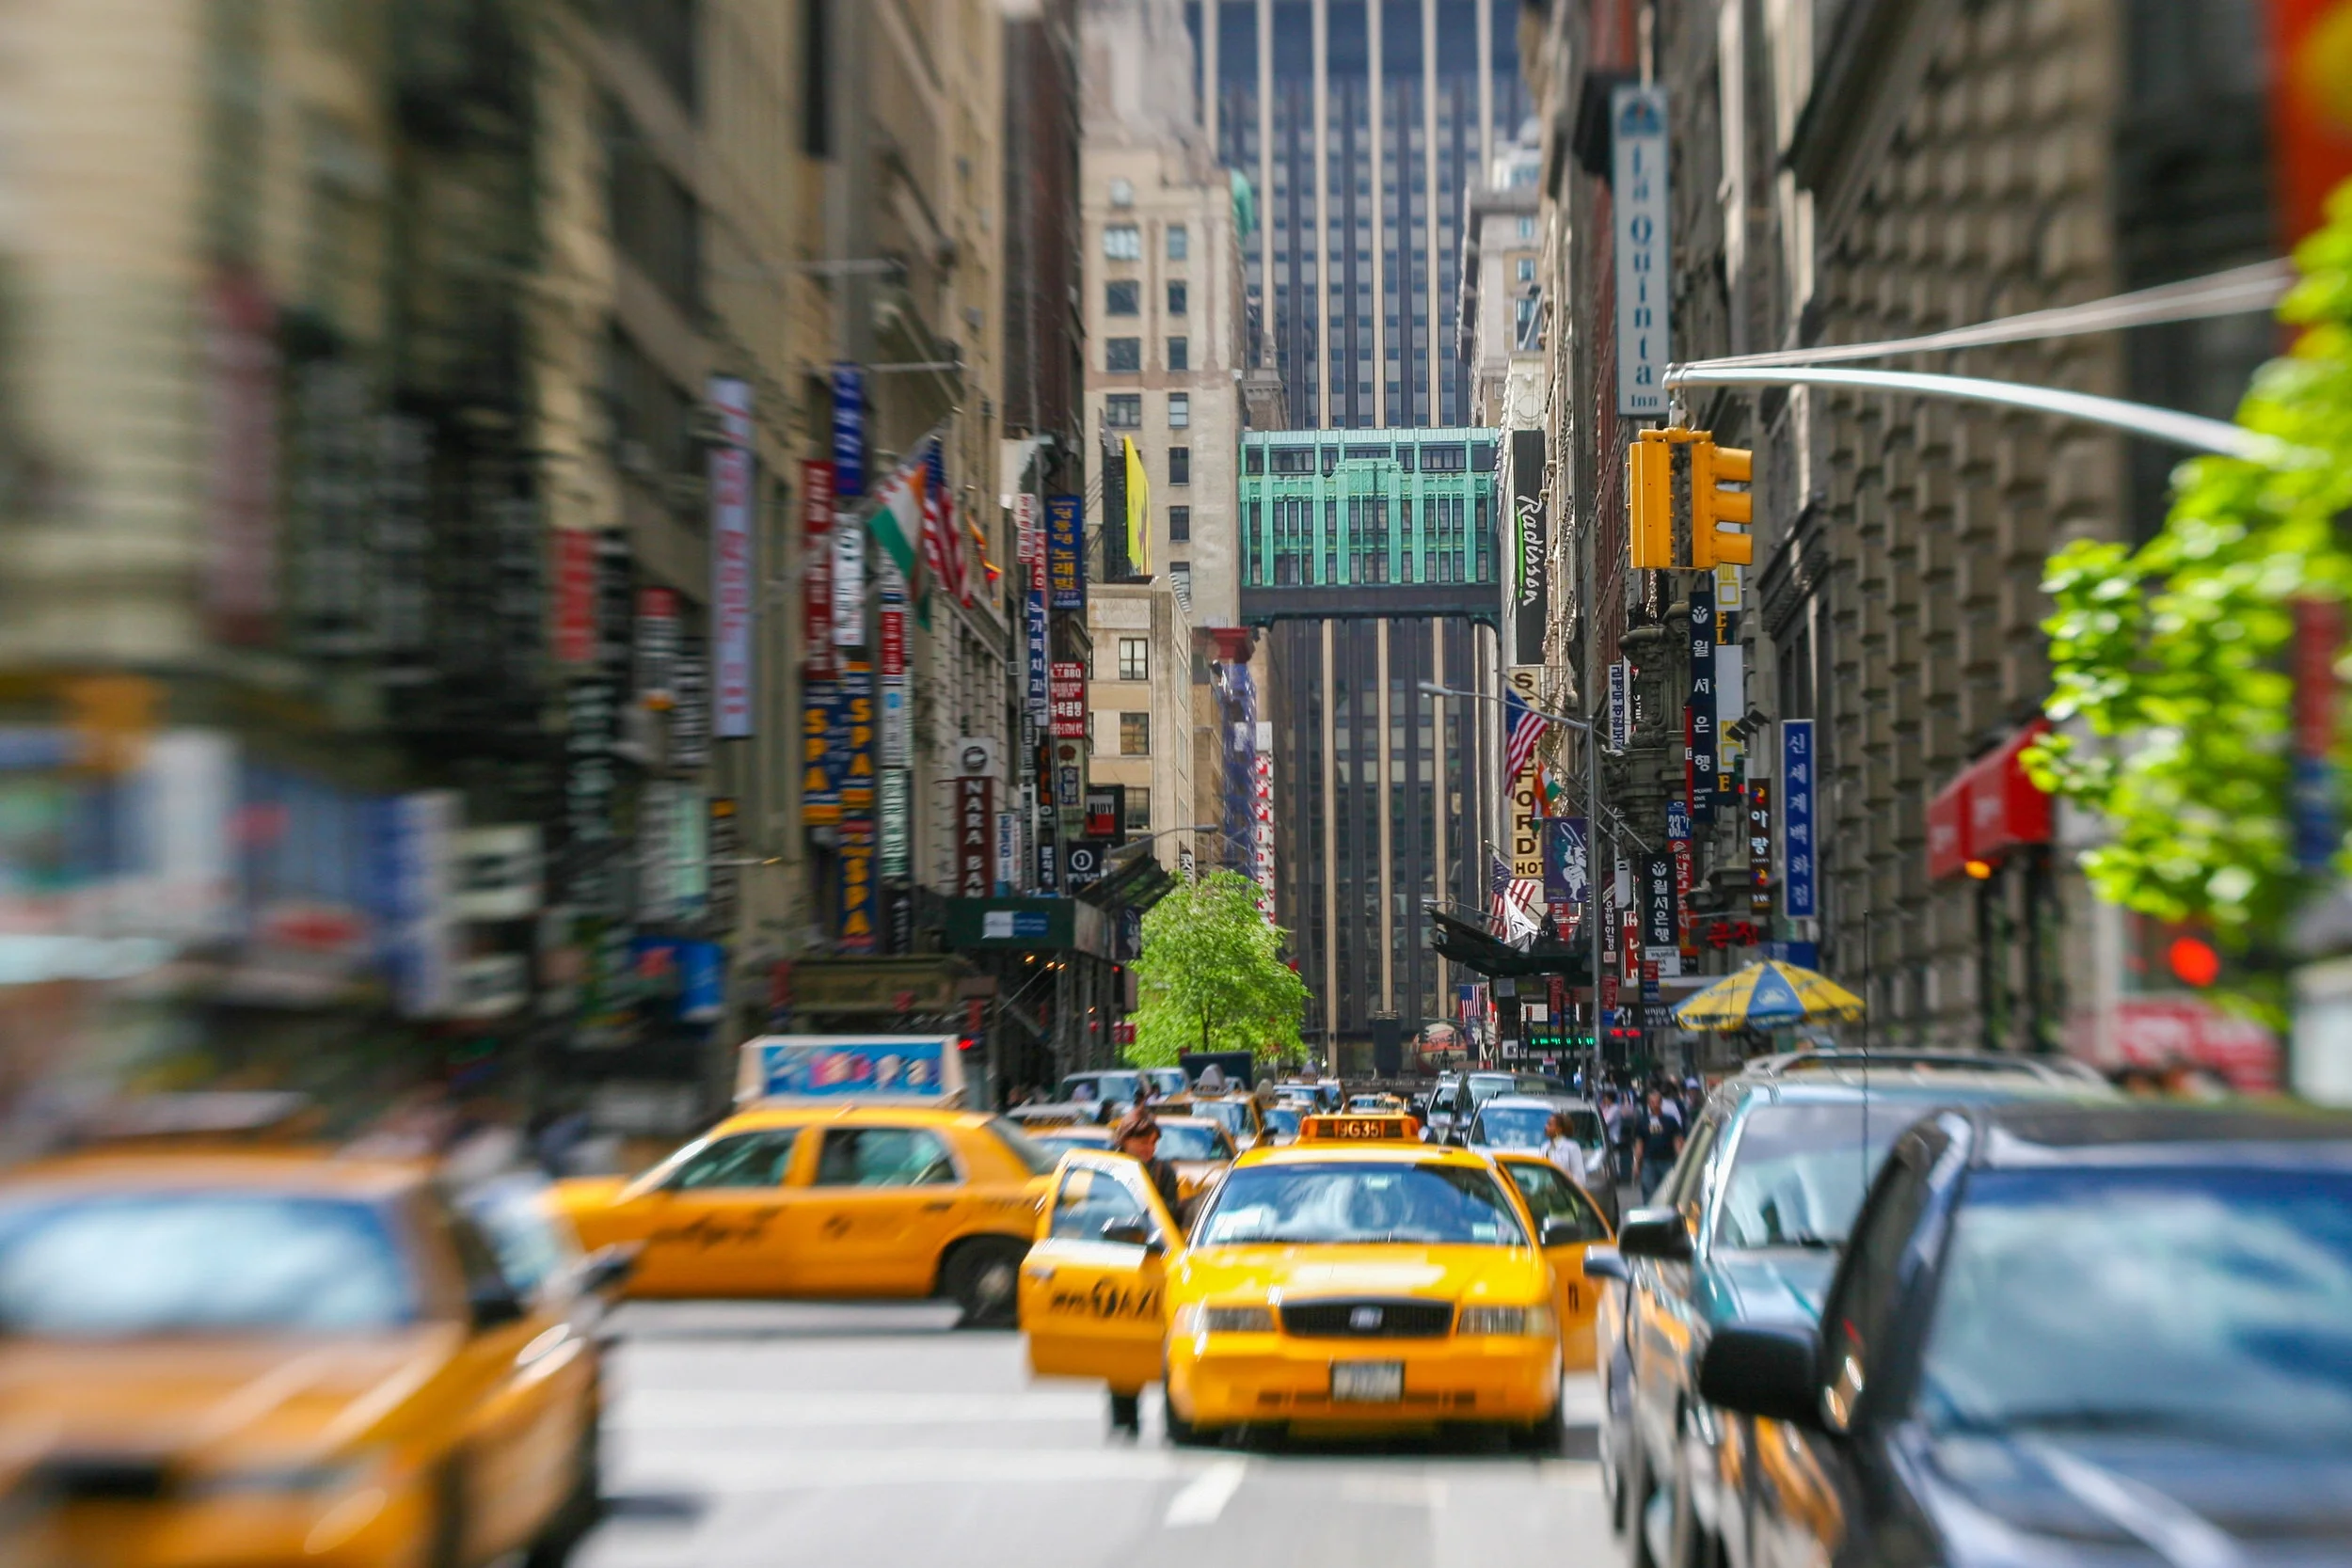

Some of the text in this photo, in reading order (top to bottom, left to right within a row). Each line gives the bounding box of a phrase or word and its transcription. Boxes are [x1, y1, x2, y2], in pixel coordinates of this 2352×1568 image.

[1630, 214, 1653, 386] Quinta
[1629, 394, 1659, 408] Inn
[1516, 494, 1544, 608] Radisson
[803, 707, 829, 791] SPA
[850, 698, 872, 777] SPA
[964, 780, 985, 845] NARA
[843, 857, 869, 936] SPA
[1603, 900, 1615, 950] 유럽안경
[1652, 879, 1669, 942] 윌셔은행
[1339, 1120, 1379, 1138] 9G35
